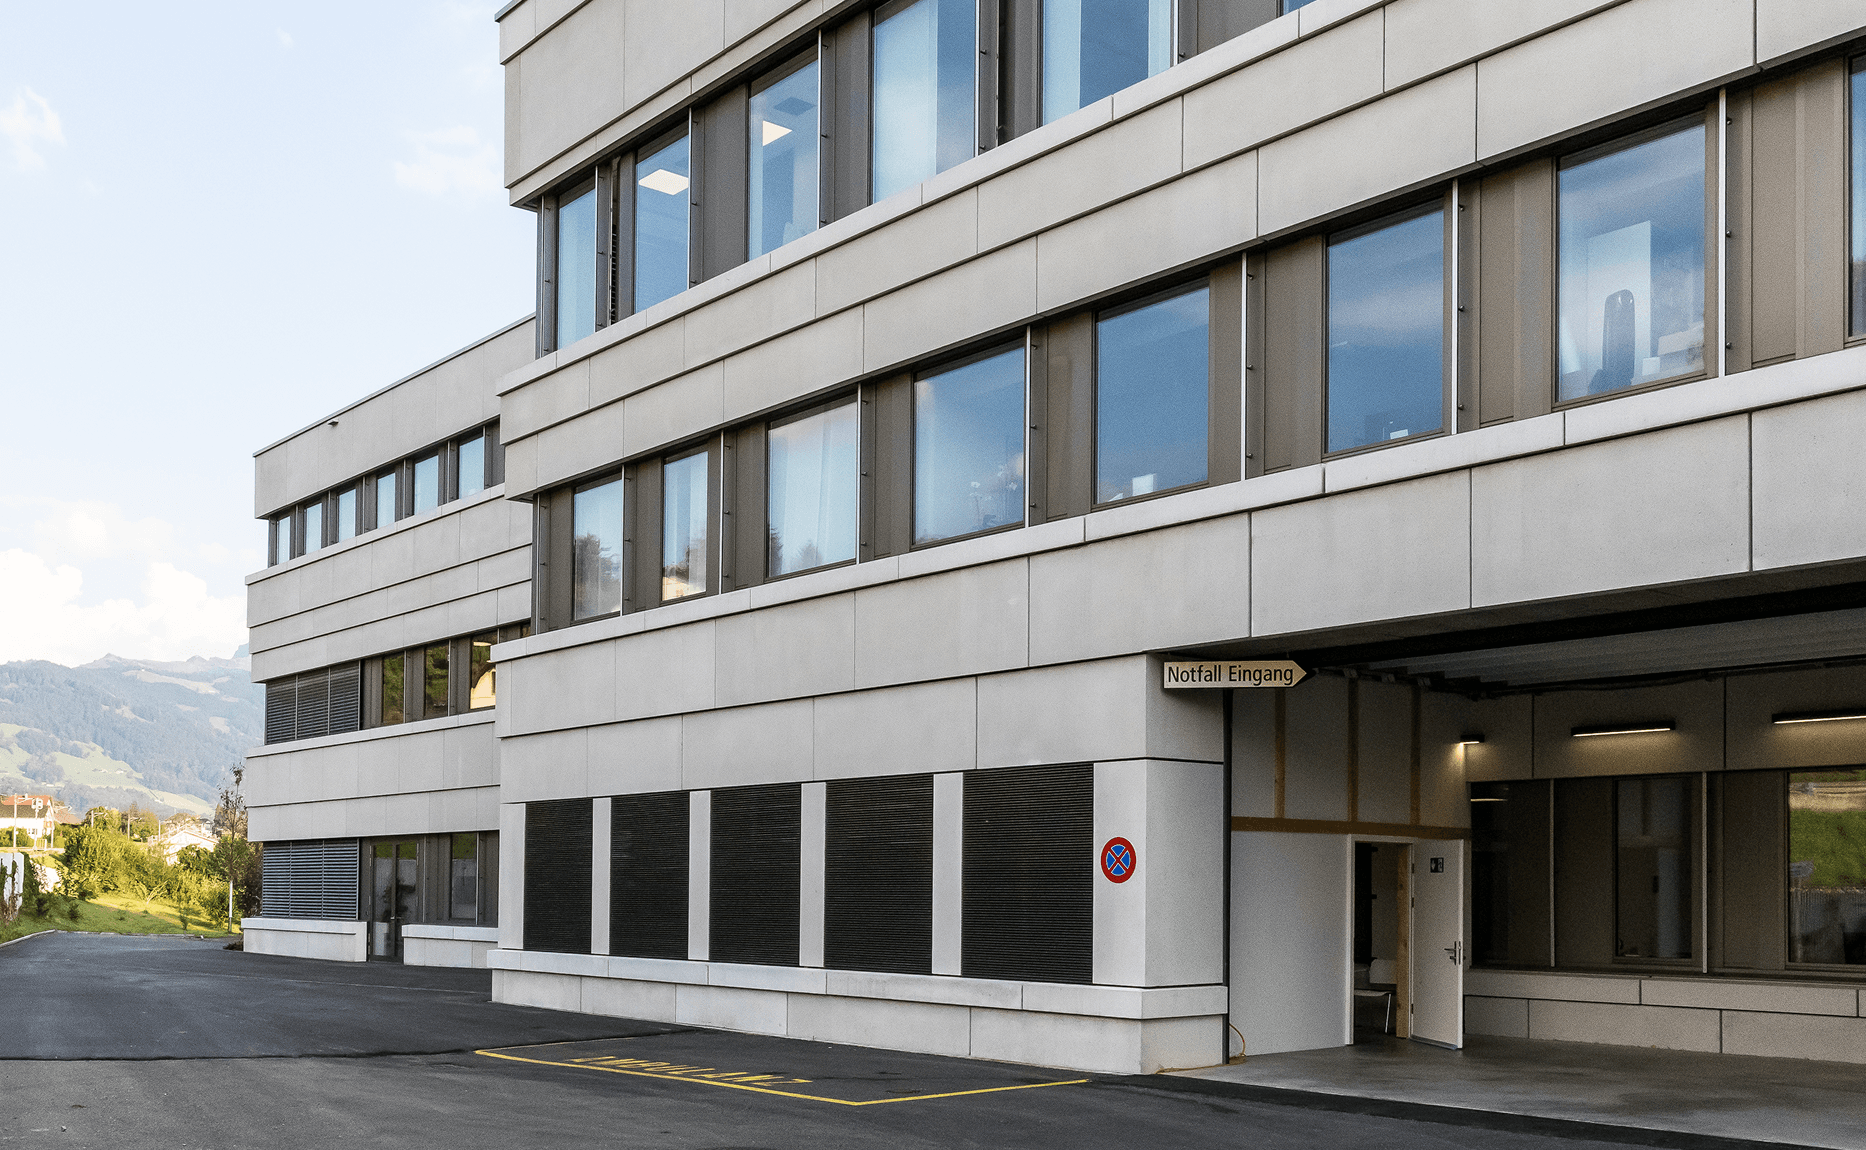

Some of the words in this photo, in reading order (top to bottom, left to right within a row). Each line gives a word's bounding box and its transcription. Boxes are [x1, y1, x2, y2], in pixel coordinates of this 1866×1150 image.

[1168, 665, 1221, 682] Notfall
[1228, 665, 1293, 686] Eingang
[565, 1056, 813, 1086] AMBULANZ
